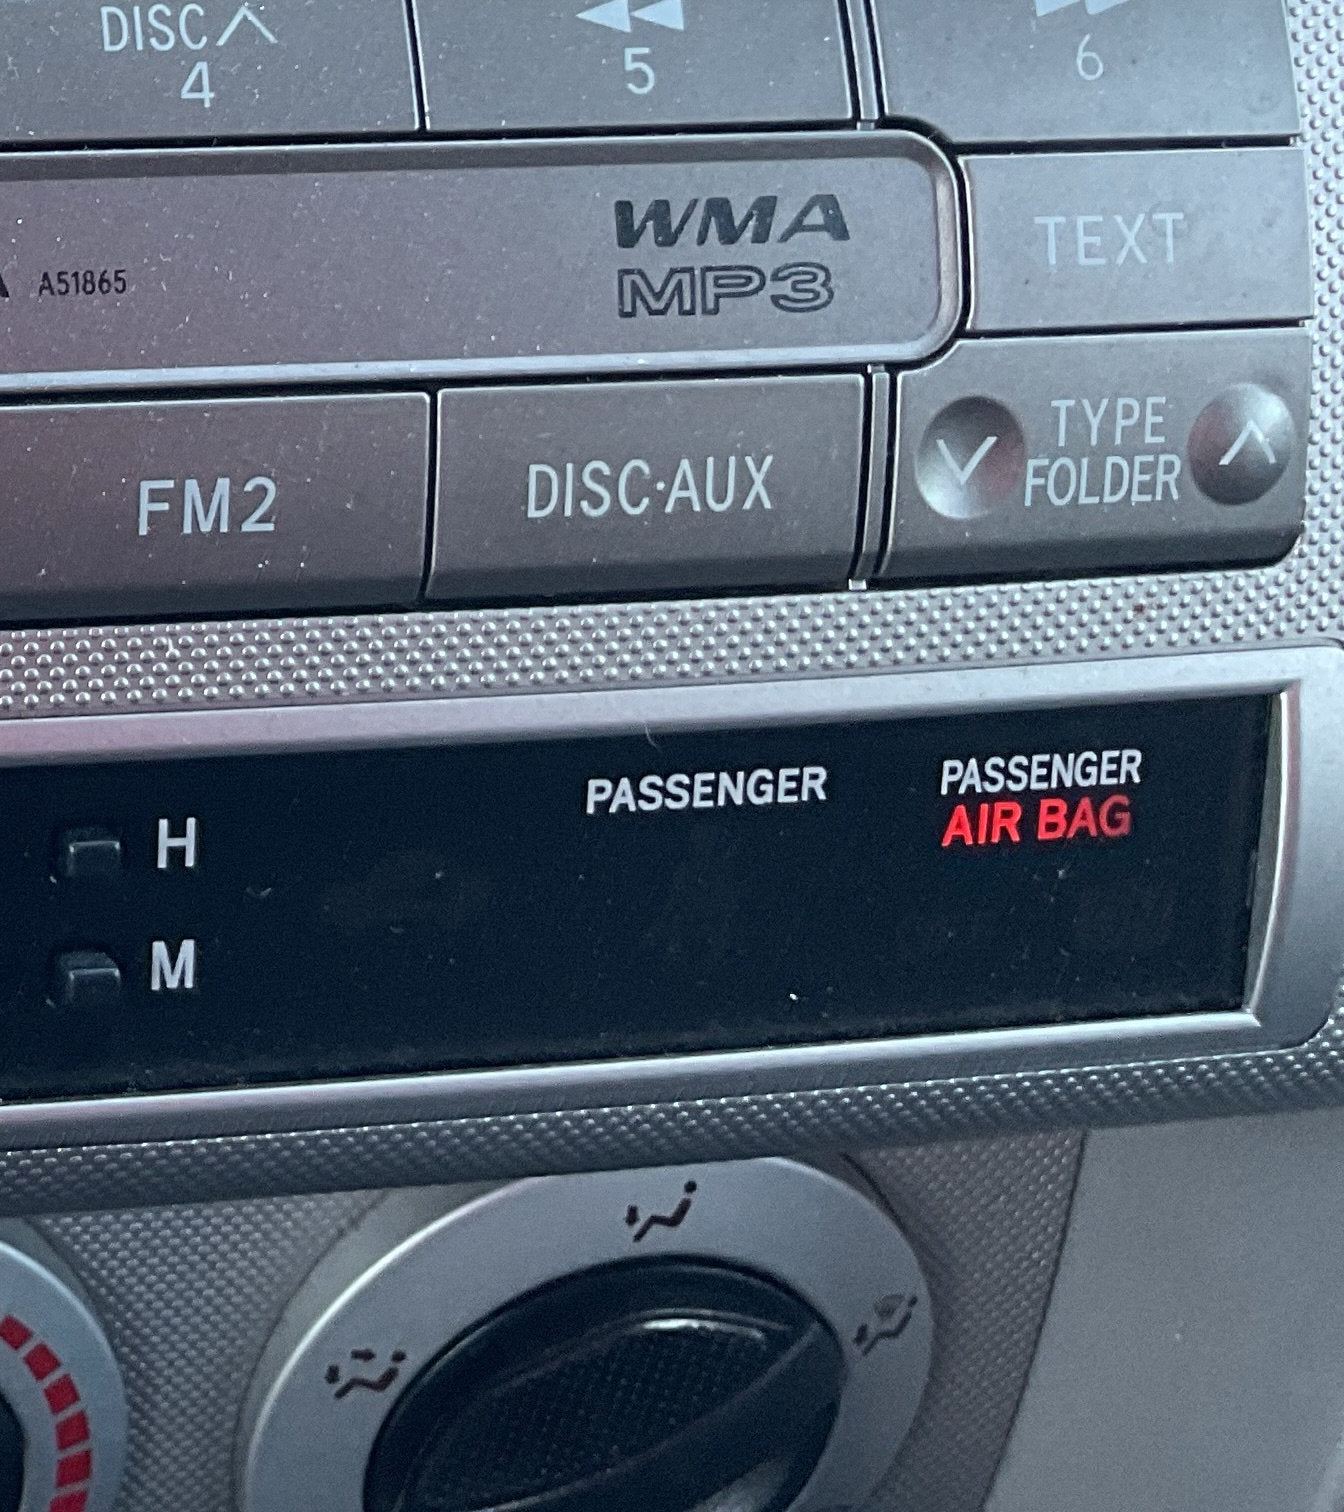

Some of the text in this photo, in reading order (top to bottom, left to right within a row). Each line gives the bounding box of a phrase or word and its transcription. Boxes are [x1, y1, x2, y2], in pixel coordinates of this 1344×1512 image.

[100, 4, 208, 53] DISC
[623, 47, 656, 95] 5
[1076, 34, 1105, 82] 6
[180, 60, 215, 110] 4
[613, 193, 851, 249] WMA
[1035, 211, 1185, 267] TEXT
[38, 269, 128, 298] A51865
[617, 262, 835, 319] MP3
[1050, 397, 1168, 447] TYPE
[137, 475, 278, 536] FM2
[1023, 455, 1181, 507] FOLDER
[585, 766, 829, 815] PASSENGER
[939, 749, 1143, 796] PASSENGER
[156, 816, 197, 869] H
[941, 794, 1131, 848] AIR BAG
[149, 938, 197, 991] M
